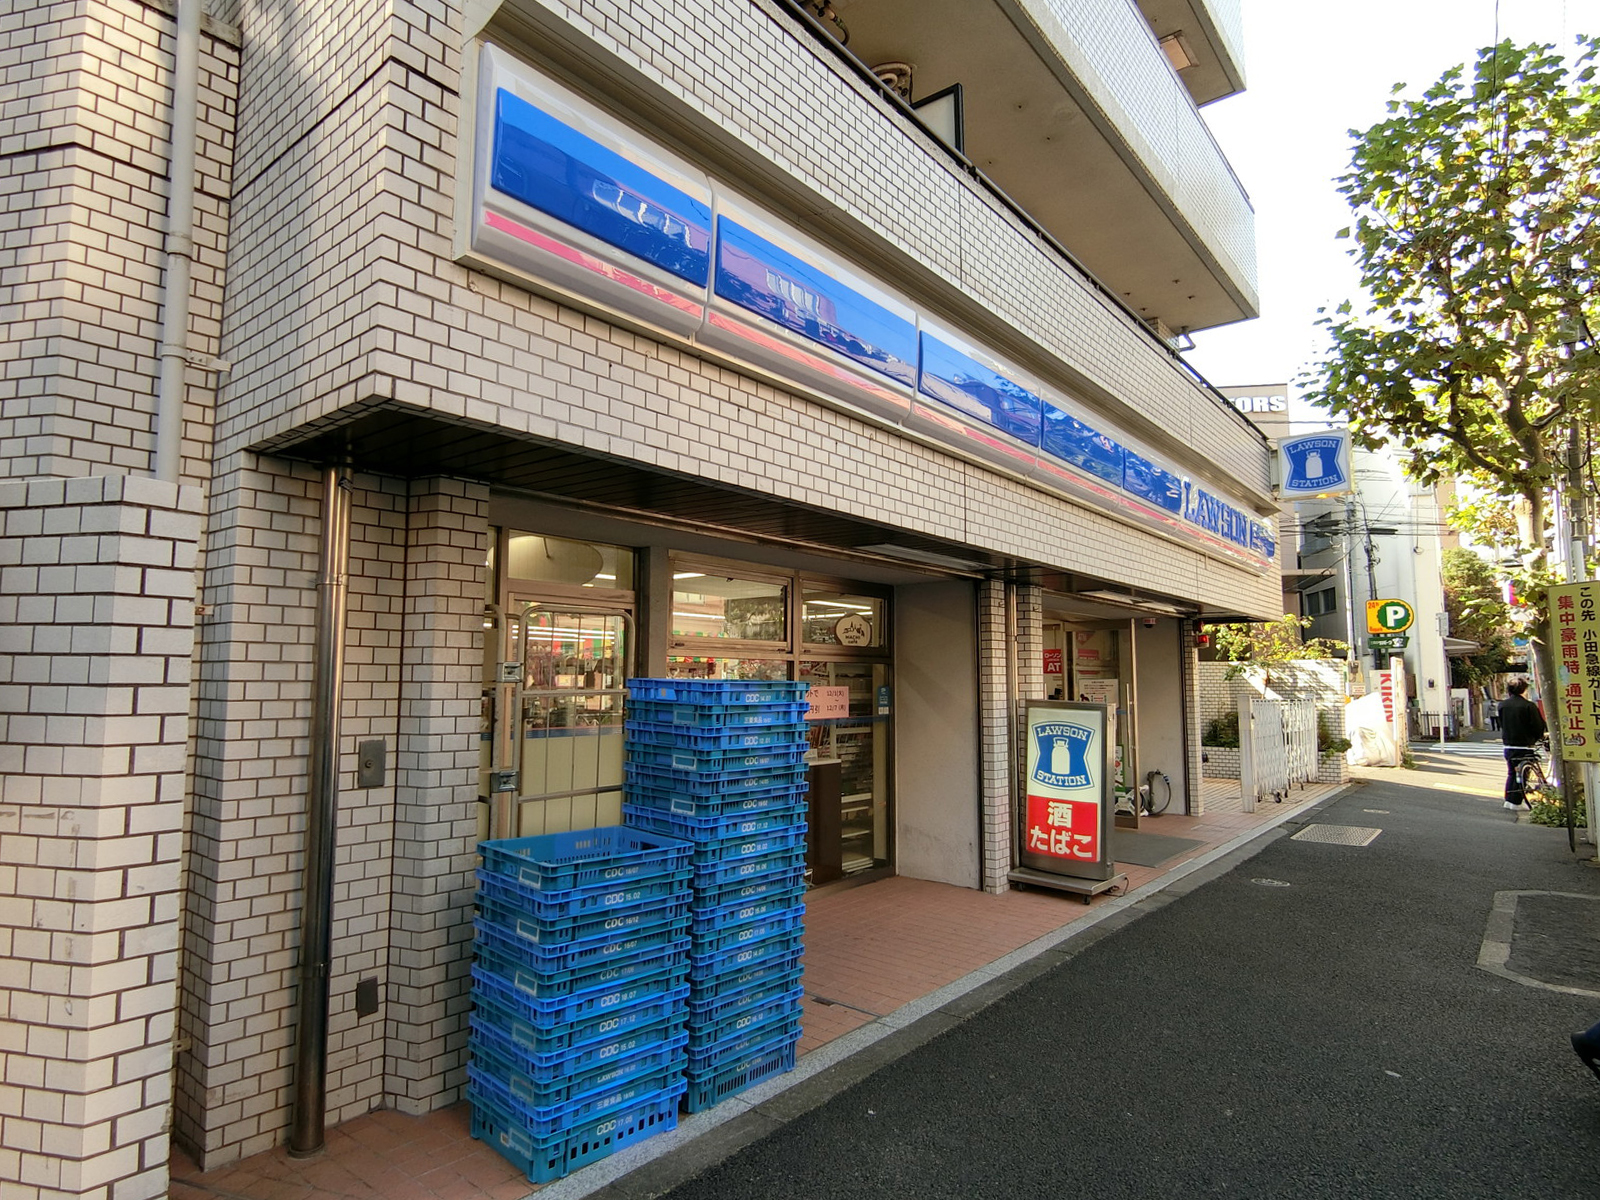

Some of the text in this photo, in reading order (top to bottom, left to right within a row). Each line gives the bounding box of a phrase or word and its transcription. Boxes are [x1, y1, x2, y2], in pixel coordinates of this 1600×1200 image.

[1289, 440, 1337, 454] LAWSON
[1292, 474, 1339, 487] STATION
[1183, 481, 1248, 548] LAWSON
[1580, 586, 1595, 622] この先
[1386, 605, 1405, 627] P
[1557, 595, 1580, 674] 集中豪雨時
[1380, 673, 1393, 723] KIRIN
[1037, 725, 1088, 741] LAWSON
[745, 757, 758, 765] CDC
[745, 778, 758, 786] CDC
[1036, 769, 1086, 786] STATION
[743, 800, 757, 809] CDC
[1047, 801, 1073, 828] 酒
[741, 843, 756, 854] CDC
[1030, 826, 1093, 858] たばこ
[605, 867, 624, 878] CDC
[740, 864, 755, 874] CDC
[741, 886, 755, 896] CDC
[605, 892, 641, 905] CDC 15.02
[740, 907, 754, 918] CDC
[605, 917, 624, 929] CDC
[739, 929, 753, 940] CDC
[603, 942, 622, 954] CDC
[738, 951, 752, 962] CDC
[600, 968, 619, 980] CDC
[601, 993, 620, 1007] CDC
[600, 1015, 636, 1032] CDC 17.12
[737, 1016, 751, 1028] CDC
[600, 1041, 636, 1058] CDC 15.02
[596, 1119, 616, 1136] CDC
